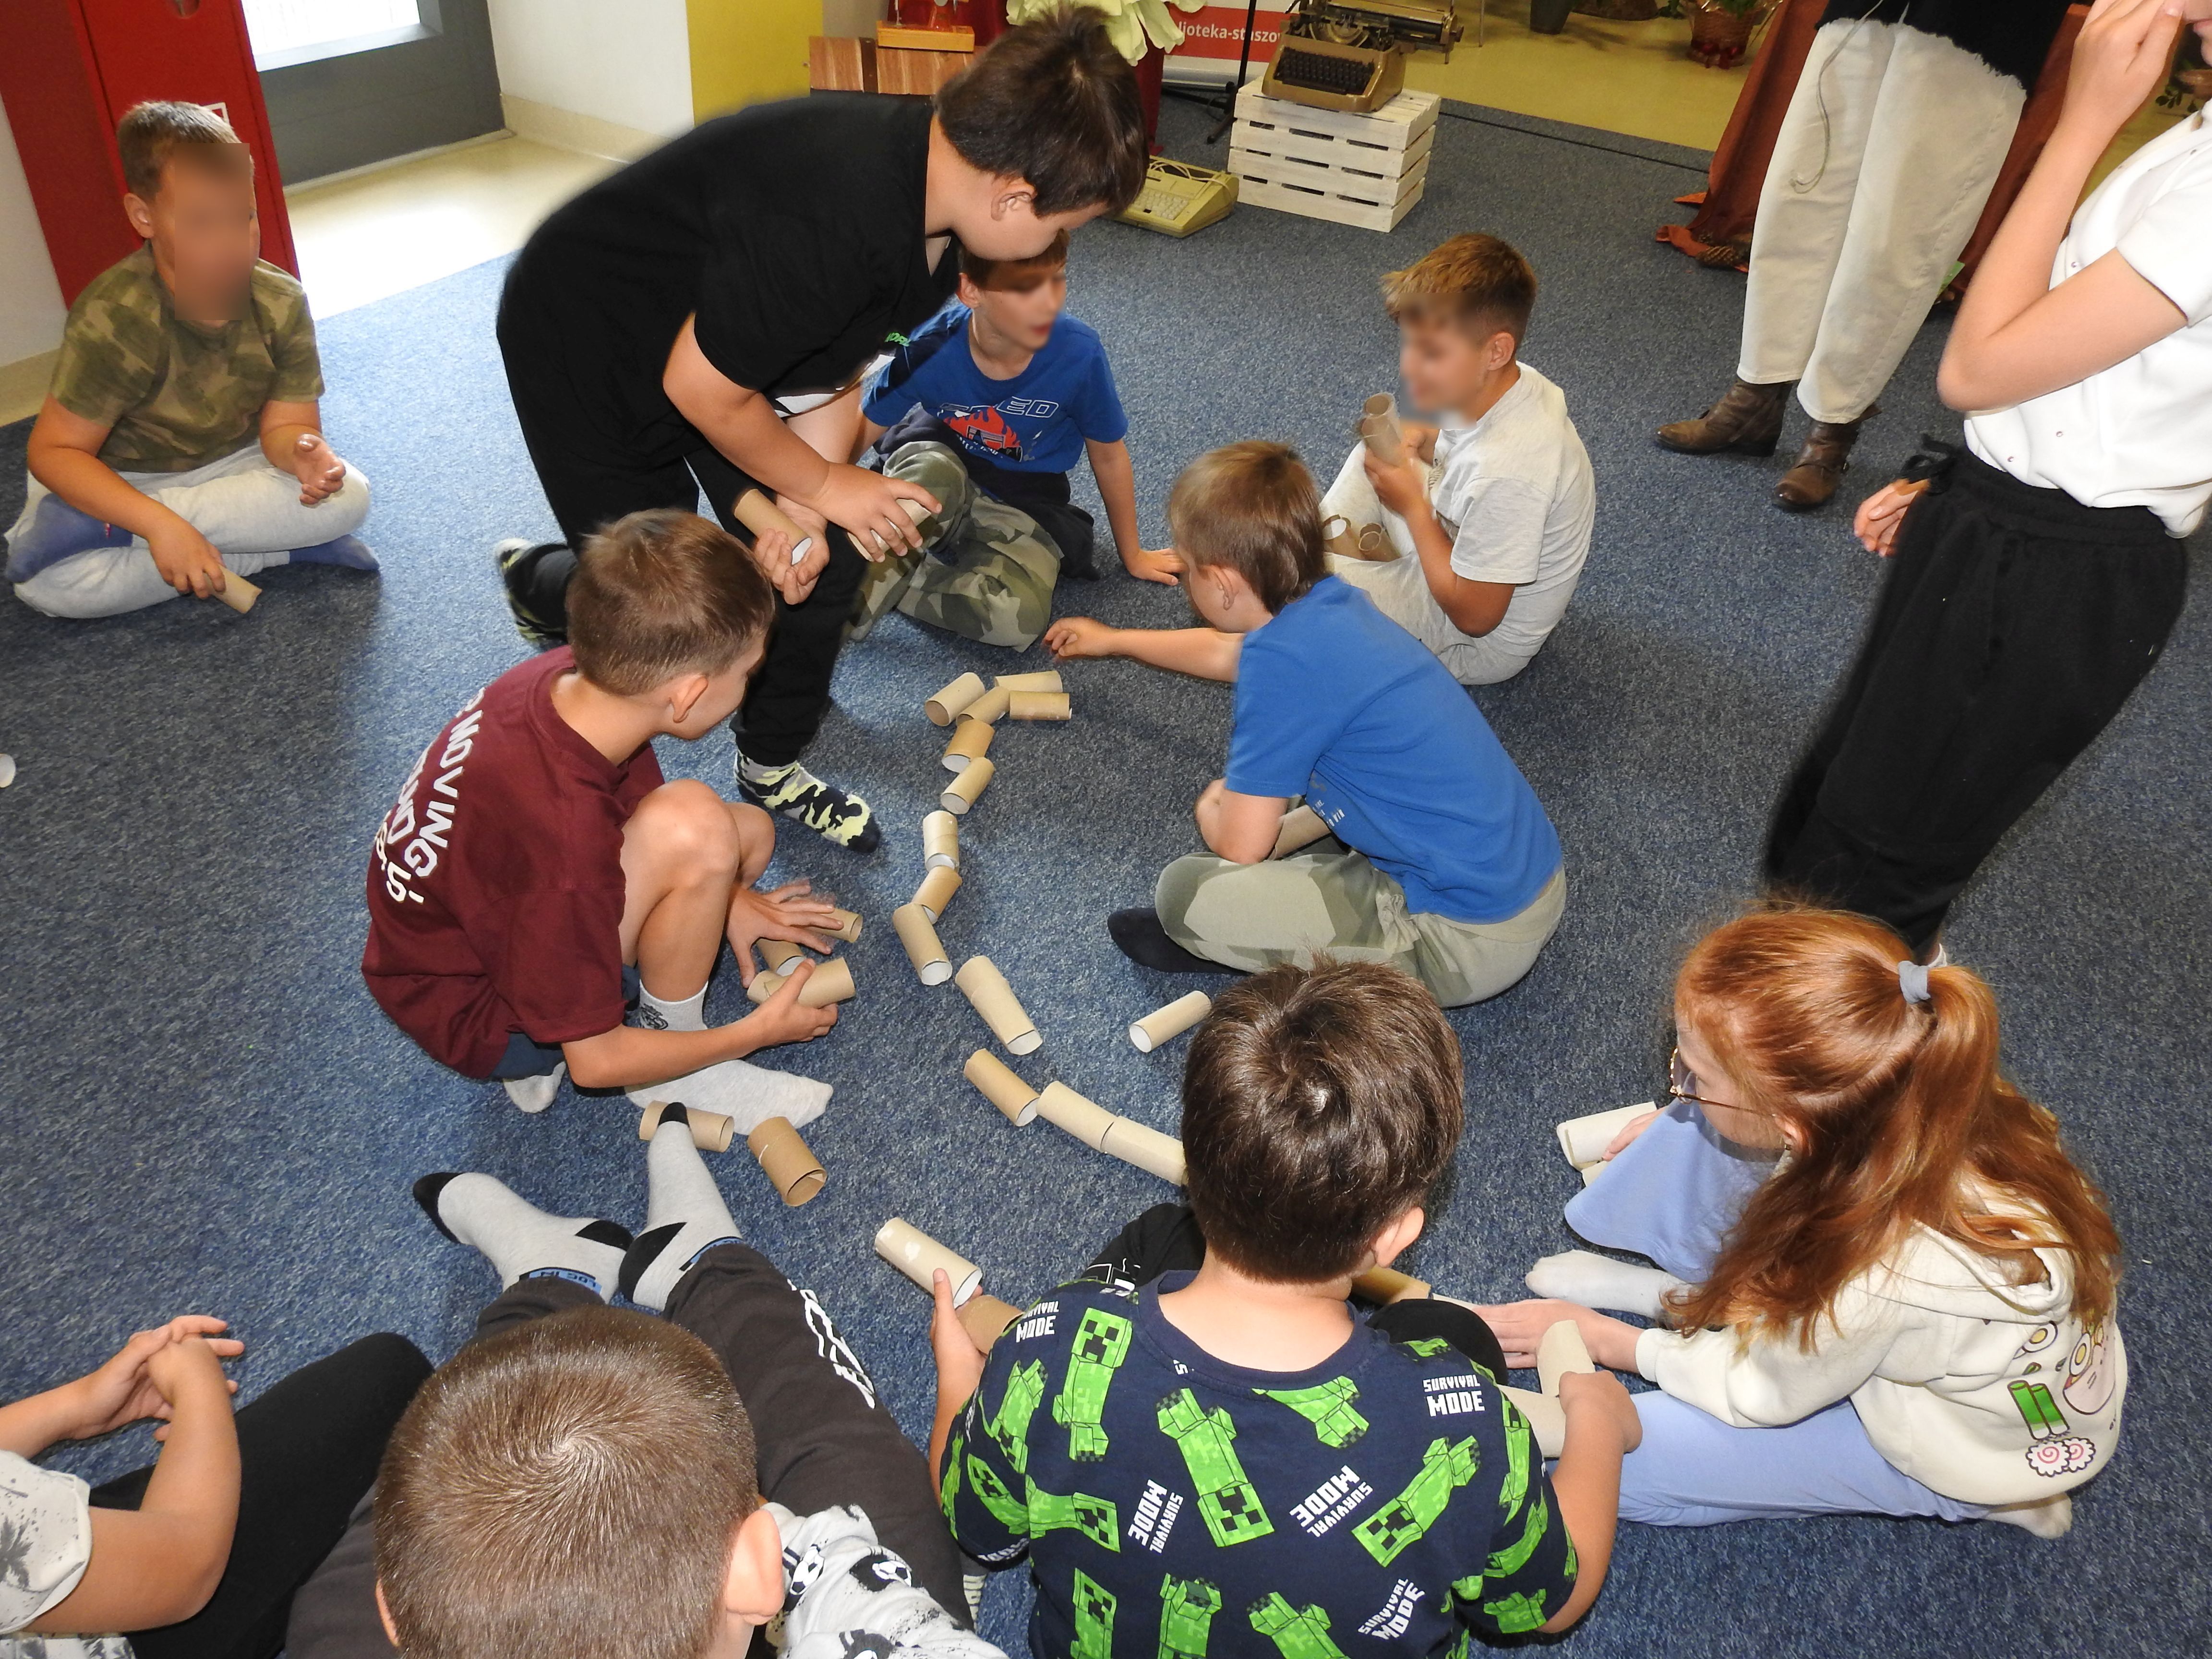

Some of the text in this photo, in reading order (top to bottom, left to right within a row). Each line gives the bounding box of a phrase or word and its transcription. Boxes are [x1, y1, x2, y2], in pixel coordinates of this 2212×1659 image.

[404, 709, 483, 877] MOVING
[1016, 1315, 1056, 1343] MODE
[1423, 1374, 1480, 1392] SURVIVAL
[1426, 1390, 1485, 1417] MODE
[1128, 1479, 1167, 1546] MODE
[1149, 1492, 1184, 1553] SURVIVAL
[1289, 1465, 1360, 1527] MODE
[1306, 1481, 1373, 1537] SURVIVAL
[1358, 1578, 1408, 1635] SURVIVAL
[1371, 1582, 1425, 1640] MODE
